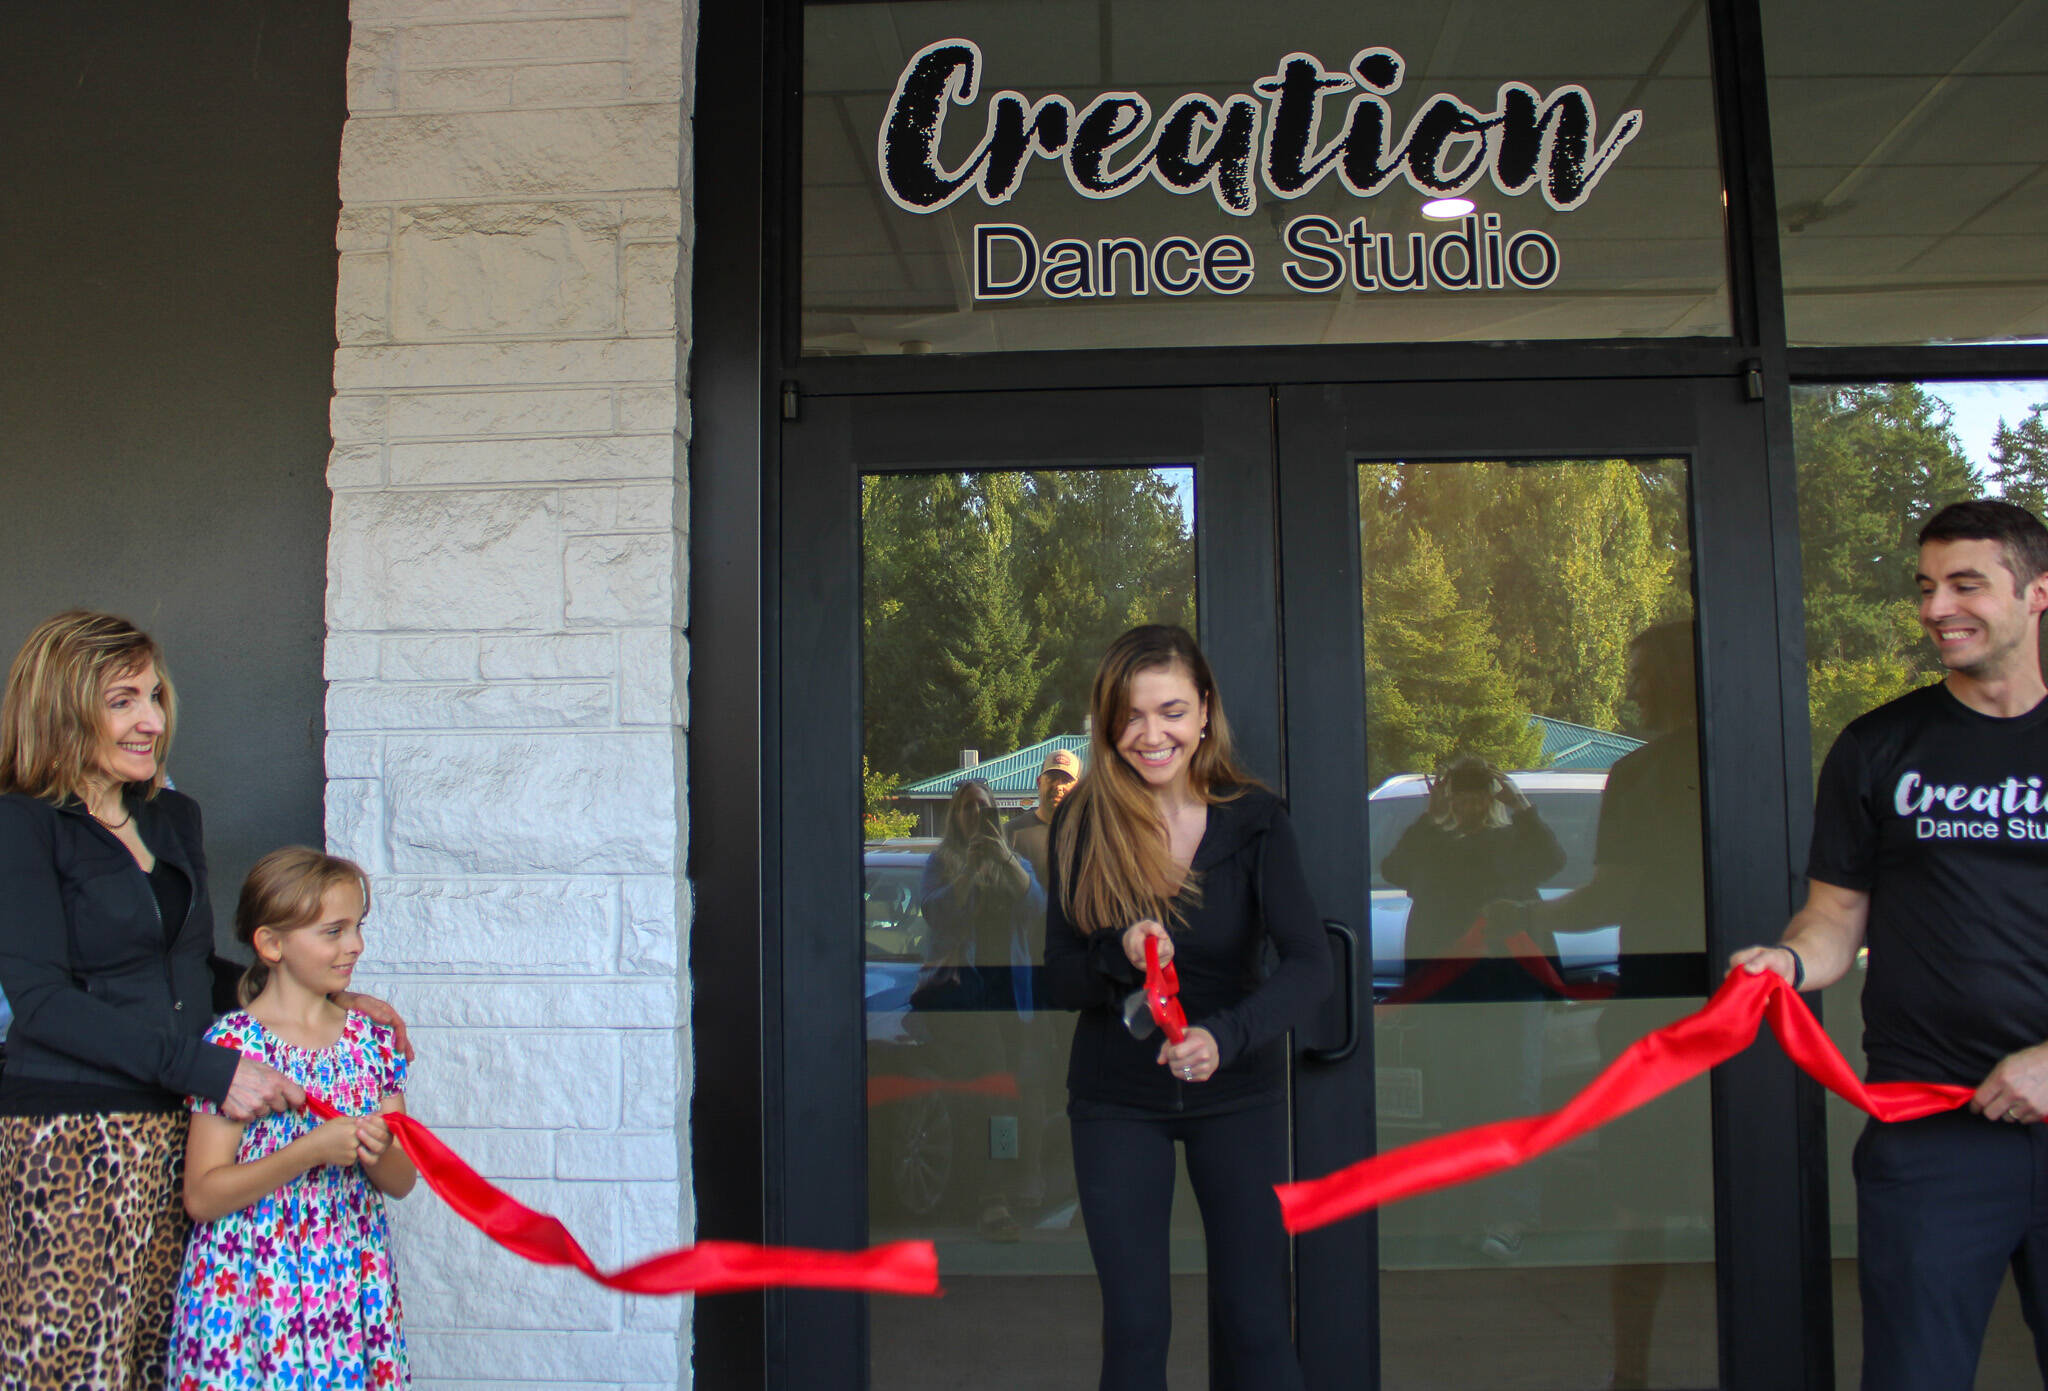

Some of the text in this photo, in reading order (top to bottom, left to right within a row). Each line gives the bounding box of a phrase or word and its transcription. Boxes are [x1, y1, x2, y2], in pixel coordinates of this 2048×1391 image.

[880, 39, 1643, 213] Creation
[975, 214, 1560, 299] Dance Studio
[1894, 771, 2048, 818] Creati
[1916, 817, 1999, 839] Dance
